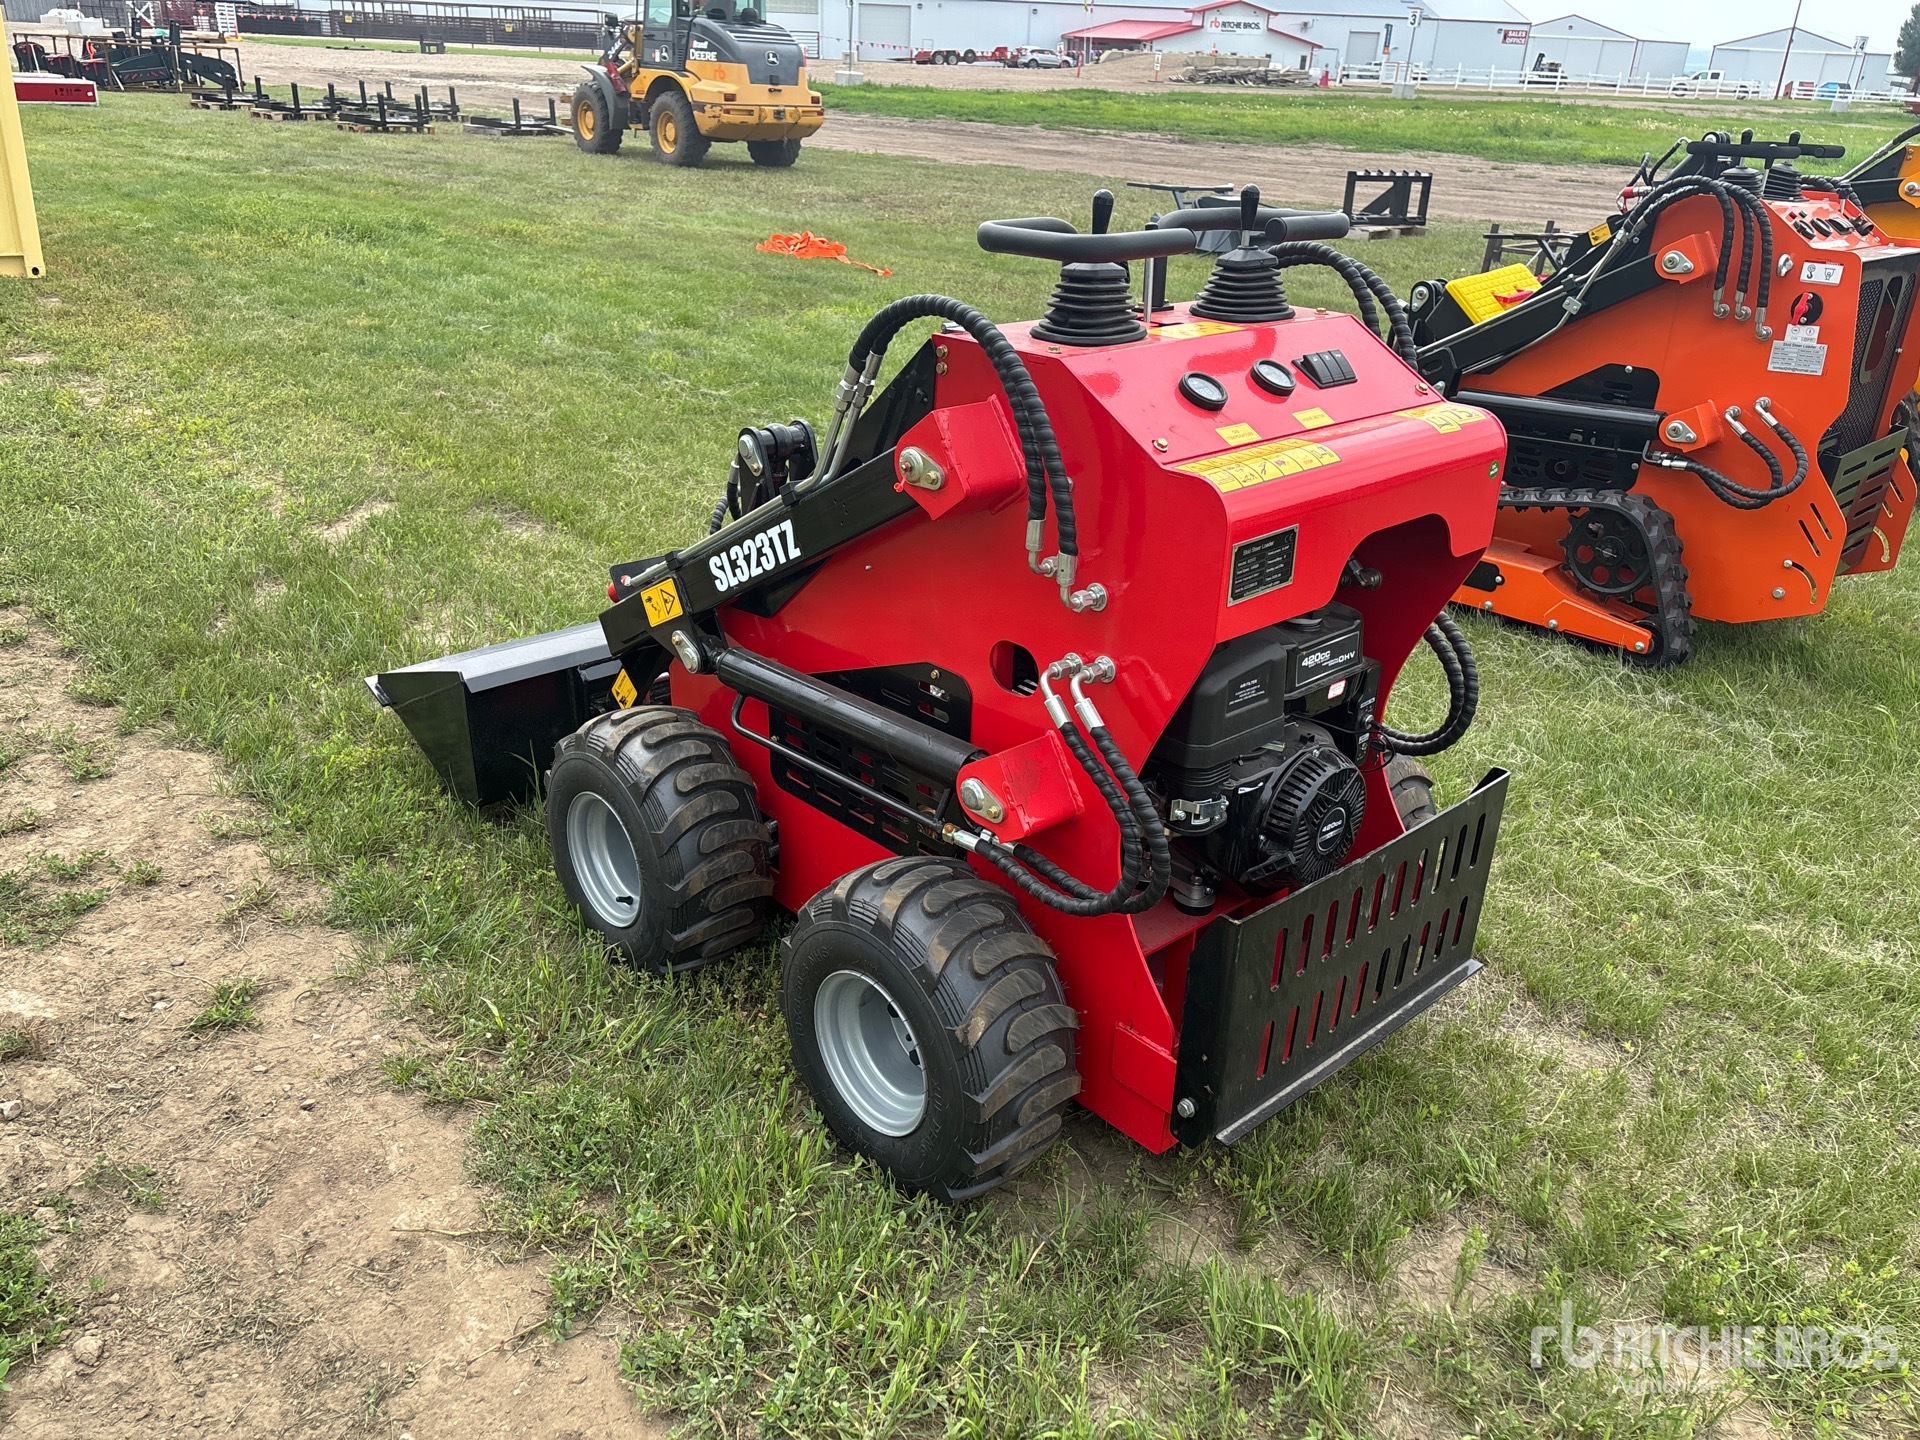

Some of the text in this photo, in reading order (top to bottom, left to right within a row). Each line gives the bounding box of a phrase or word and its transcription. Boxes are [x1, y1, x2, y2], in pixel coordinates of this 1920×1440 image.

[1210, 16, 1220, 28] rb
[1221, 21, 1242, 29] RITCHIE
[1410, 14, 1416, 25] 3
[689, 49, 718, 61] DEERE
[1242, 540, 1275, 556] Skid Steer Loader
[708, 518, 802, 592] SL323TZ
[1301, 650, 1331, 667] 420cc
[1338, 650, 1356, 663] OHV
[1322, 819, 1343, 832] 420cc
